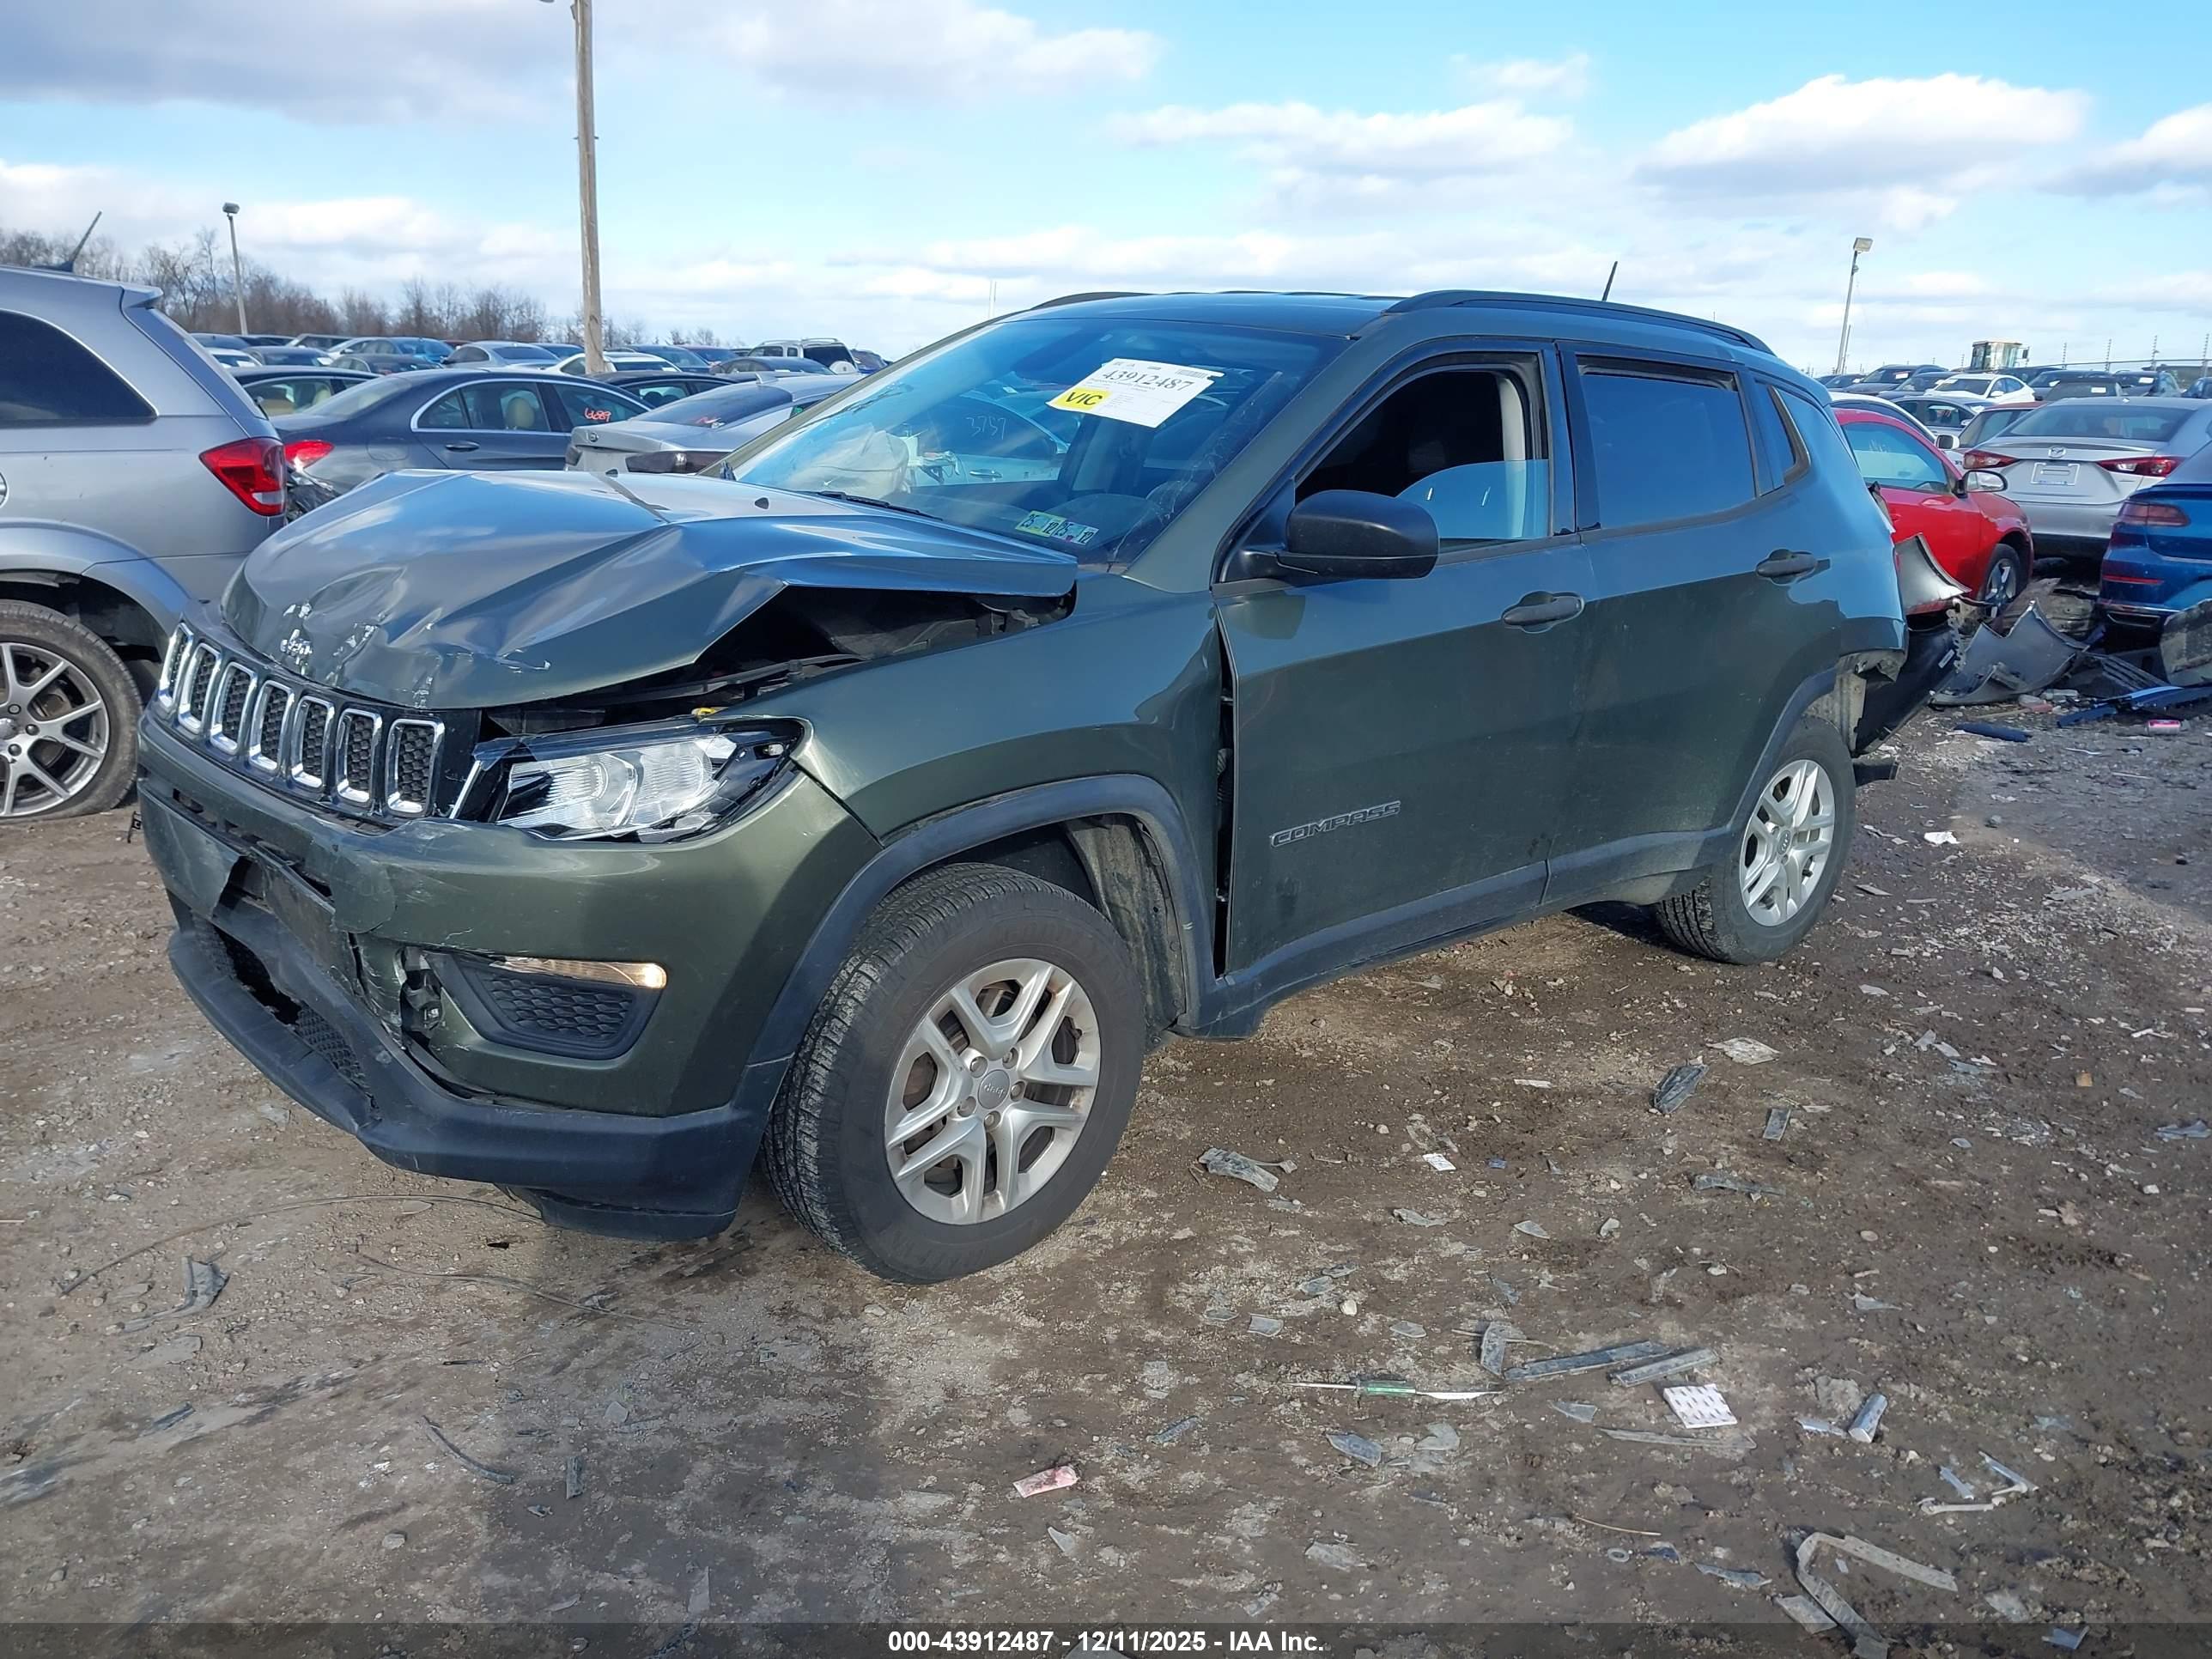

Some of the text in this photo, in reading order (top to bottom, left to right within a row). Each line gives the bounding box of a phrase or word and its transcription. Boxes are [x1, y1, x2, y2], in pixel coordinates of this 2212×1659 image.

[1103, 369, 1196, 392] 43912487
[1066, 392, 1103, 406] VIC
[1019, 514, 1060, 534] 25 12
[1054, 520, 1095, 544] 25 12
[1270, 799, 1401, 848] COMPASS
